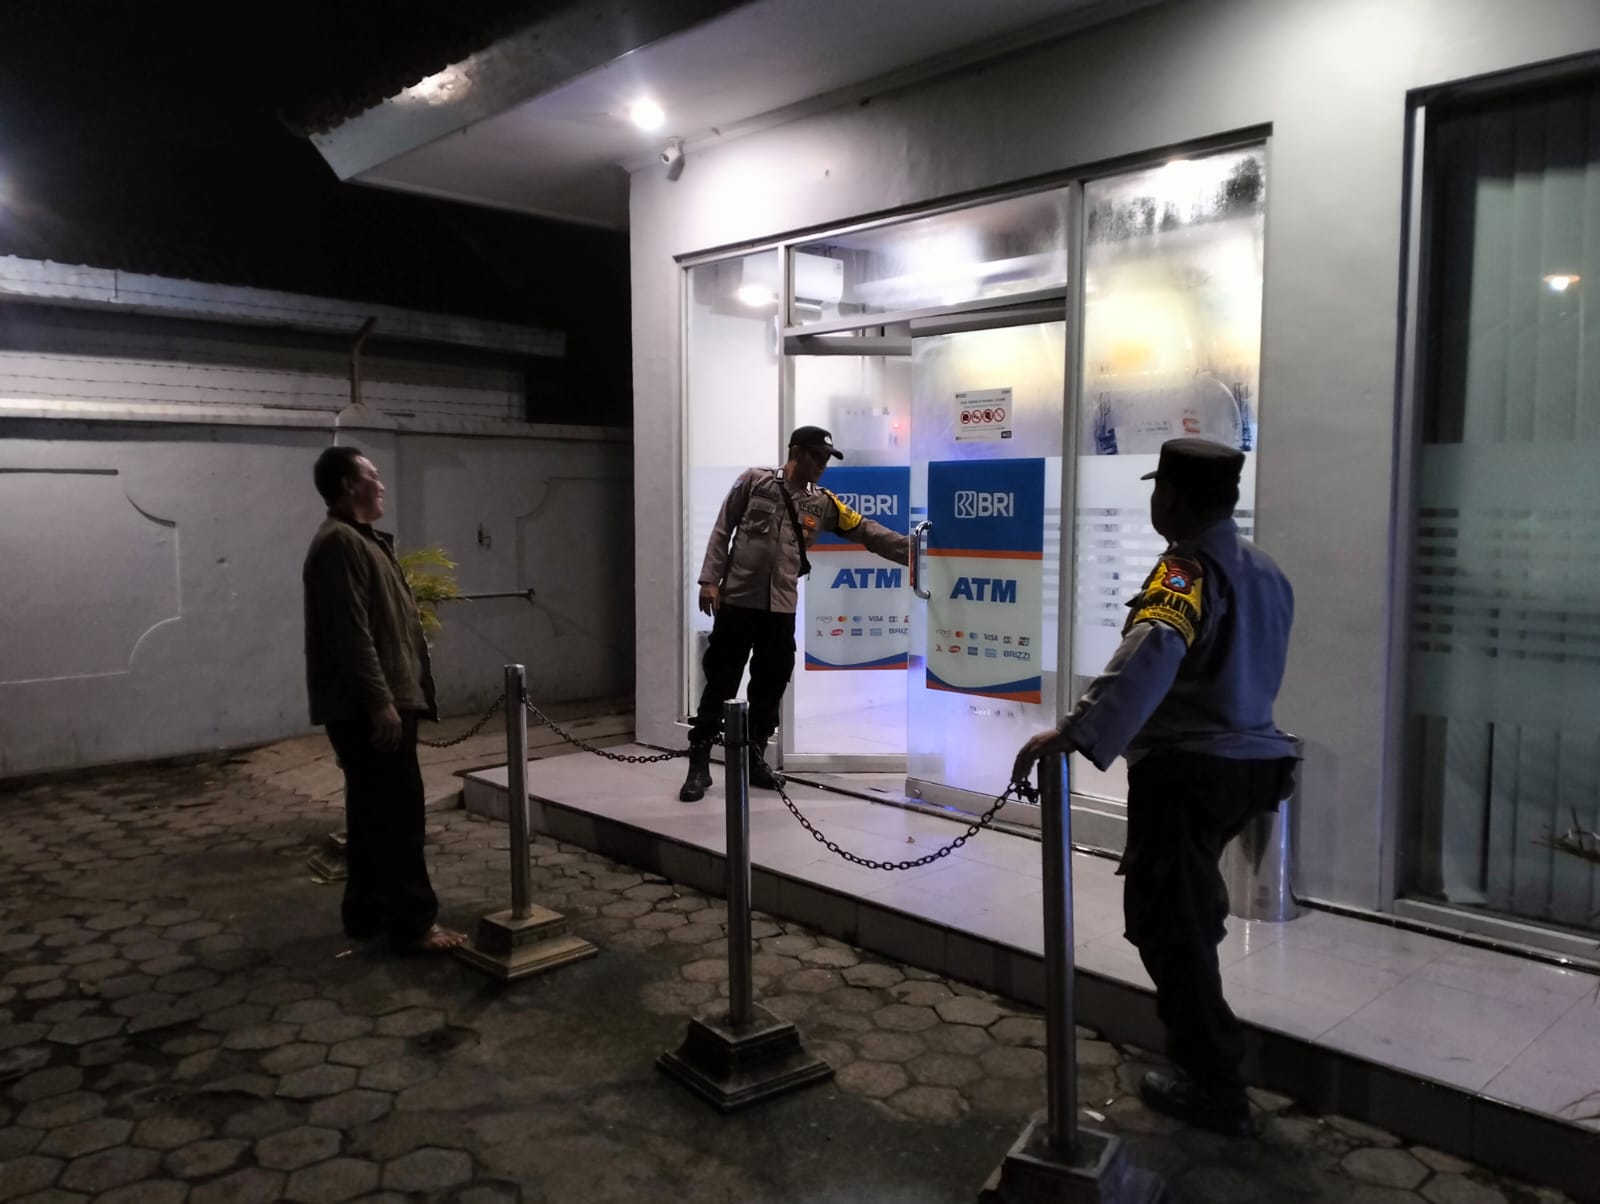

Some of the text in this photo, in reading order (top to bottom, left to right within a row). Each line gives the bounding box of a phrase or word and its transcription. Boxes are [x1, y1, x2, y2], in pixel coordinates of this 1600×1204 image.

[859, 494, 899, 516] BRI
[977, 492, 1015, 518] BRI
[830, 568, 902, 589] ATM
[949, 576, 1017, 604] ATM
[888, 627, 909, 635] BRIZ
[983, 633, 999, 642] VISA
[1003, 650, 1031, 661] BRIZZI
